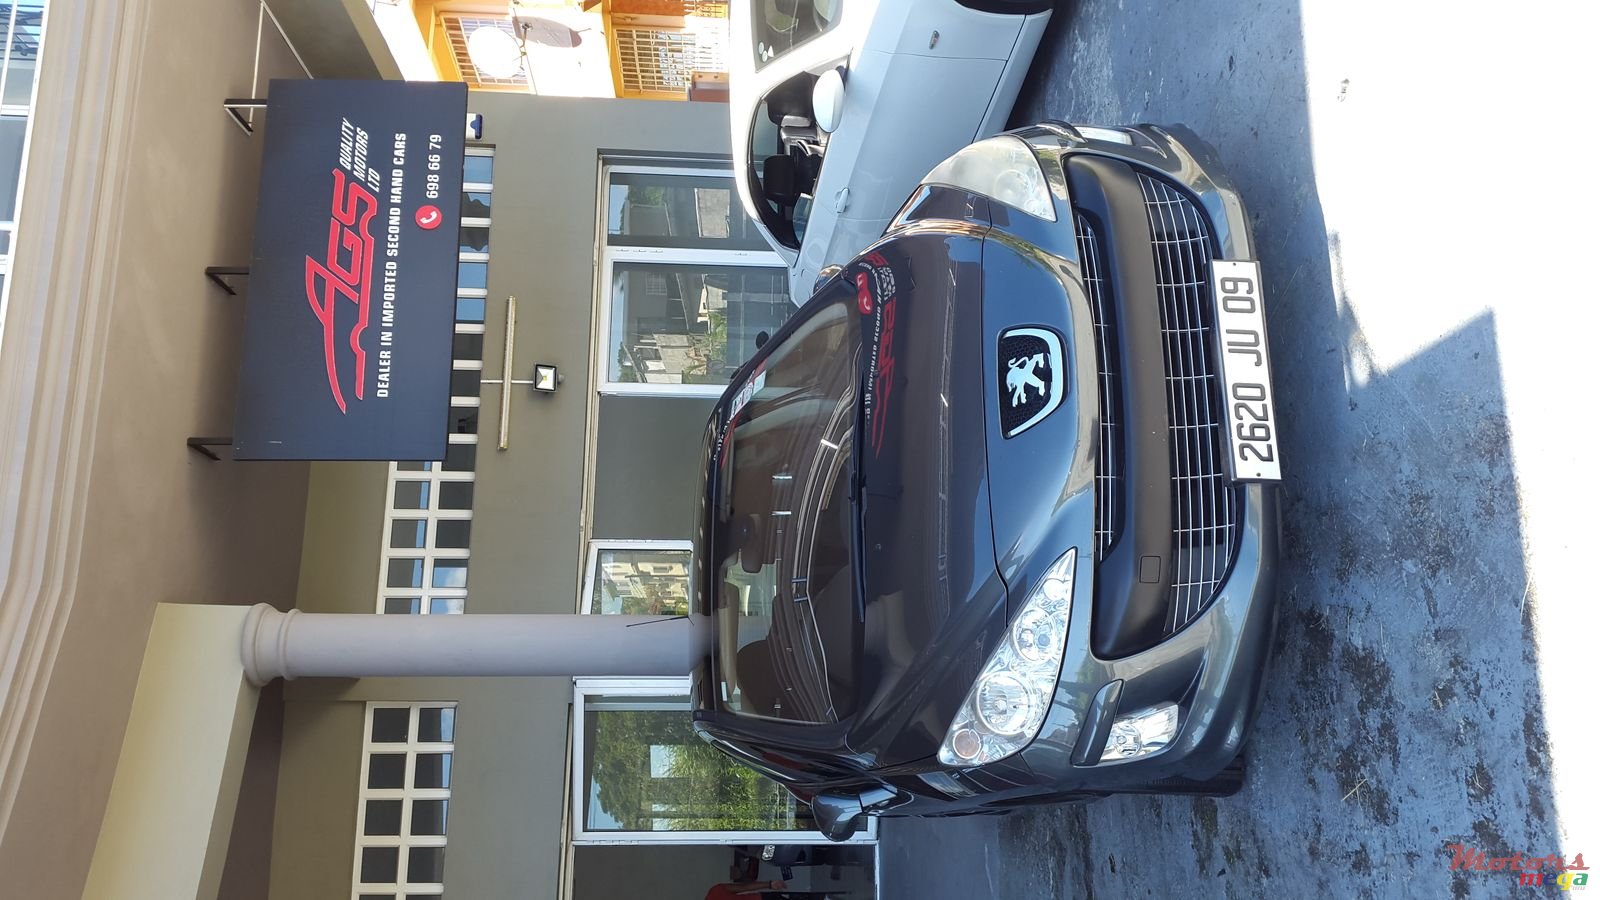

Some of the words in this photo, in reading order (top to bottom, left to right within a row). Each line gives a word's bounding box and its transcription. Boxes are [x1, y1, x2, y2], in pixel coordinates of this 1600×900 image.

[339, 118, 354, 170] QUALITY
[353, 127, 368, 181] MOTORS
[393, 133, 406, 165] CARS
[428, 134, 442, 150] 79
[427, 153, 441, 170] 66
[368, 169, 381, 192] LTD
[390, 169, 404, 203] HAND
[425, 175, 440, 199] 698
[387, 208, 401, 256] SECOND
[381, 262, 397, 327] IMPORTED
[1220, 277, 1256, 313] 09
[380, 332, 392, 346] IN
[1226, 329, 1262, 366] JU
[377, 350, 391, 398] DEALER
[1232, 383, 1274, 462] 2620
